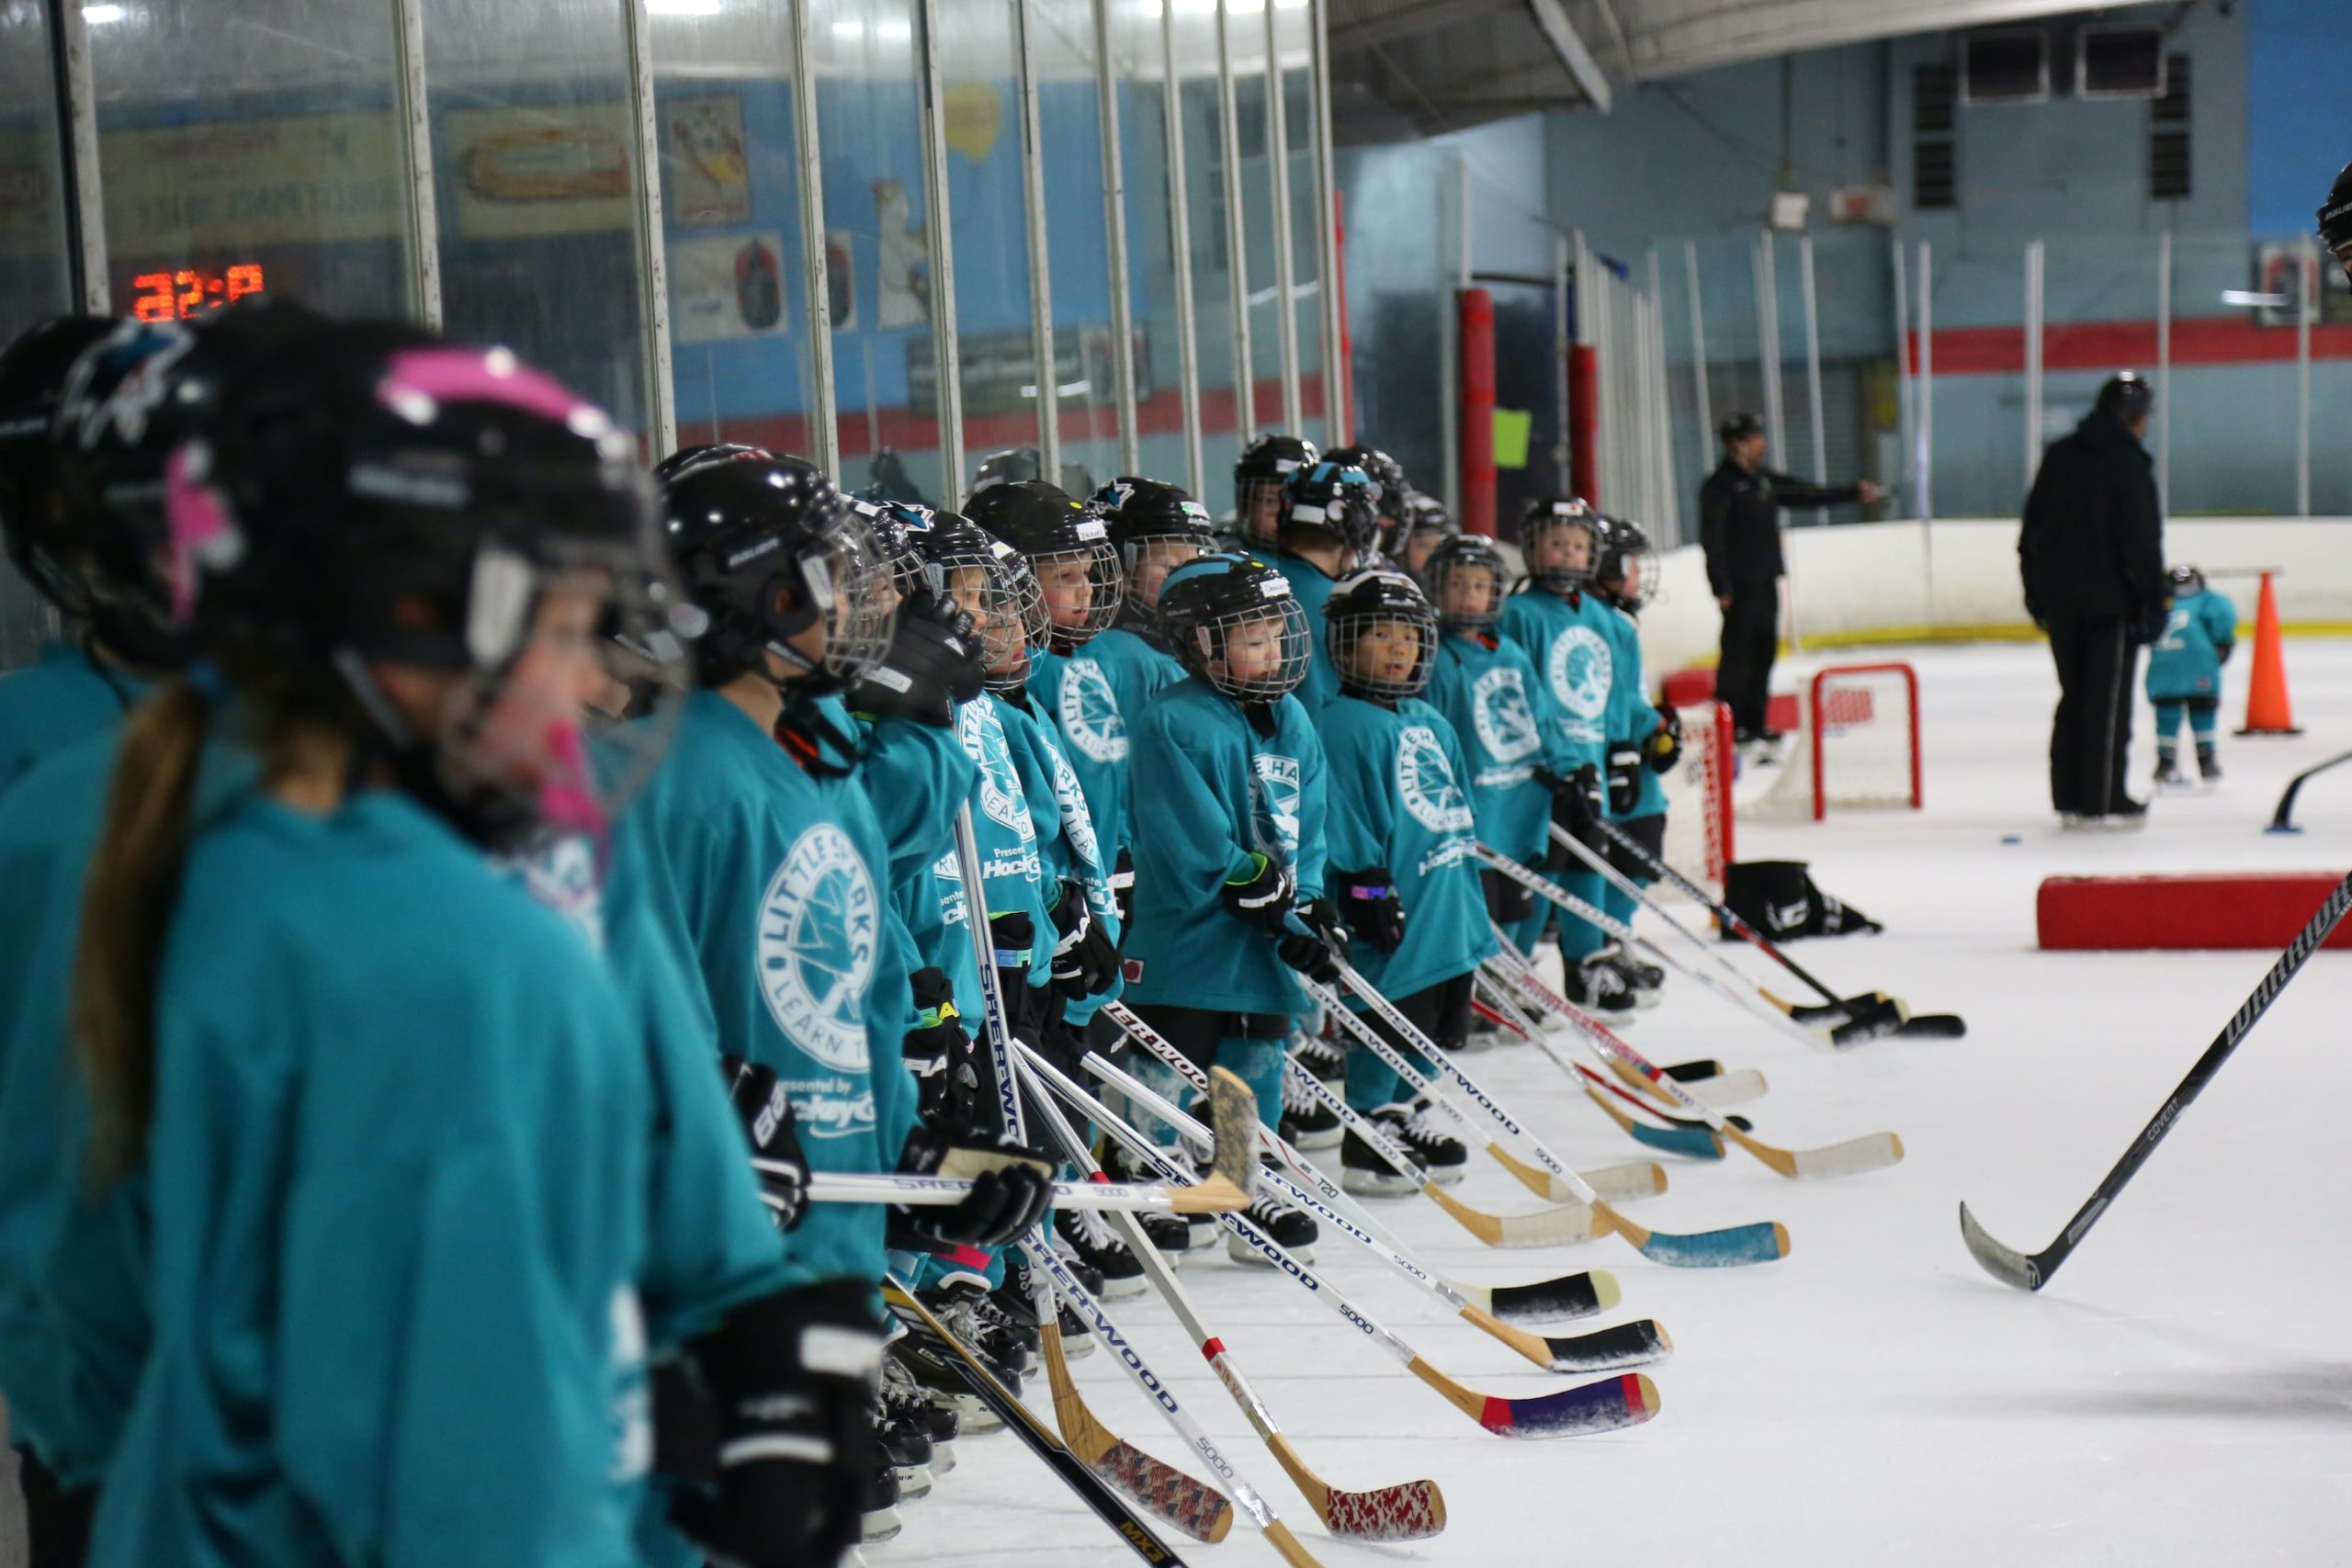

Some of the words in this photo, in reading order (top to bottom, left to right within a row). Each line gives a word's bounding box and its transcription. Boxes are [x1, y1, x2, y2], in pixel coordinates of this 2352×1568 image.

[763, 834, 826, 942] LITTLE
[774, 980, 844, 1055] LEARN
[979, 963, 1021, 1135] SHER-WO
[2146, 1097, 2180, 1142] COVERT
[1535, 1147, 1563, 1175] 5000
[1317, 1177, 1340, 1200] T20
[1393, 1254, 1427, 1280] 5000
[1338, 1303, 1375, 1335] 5000
[1195, 1437, 1235, 1480] 5000
[1121, 1520, 1165, 1563] MX3
